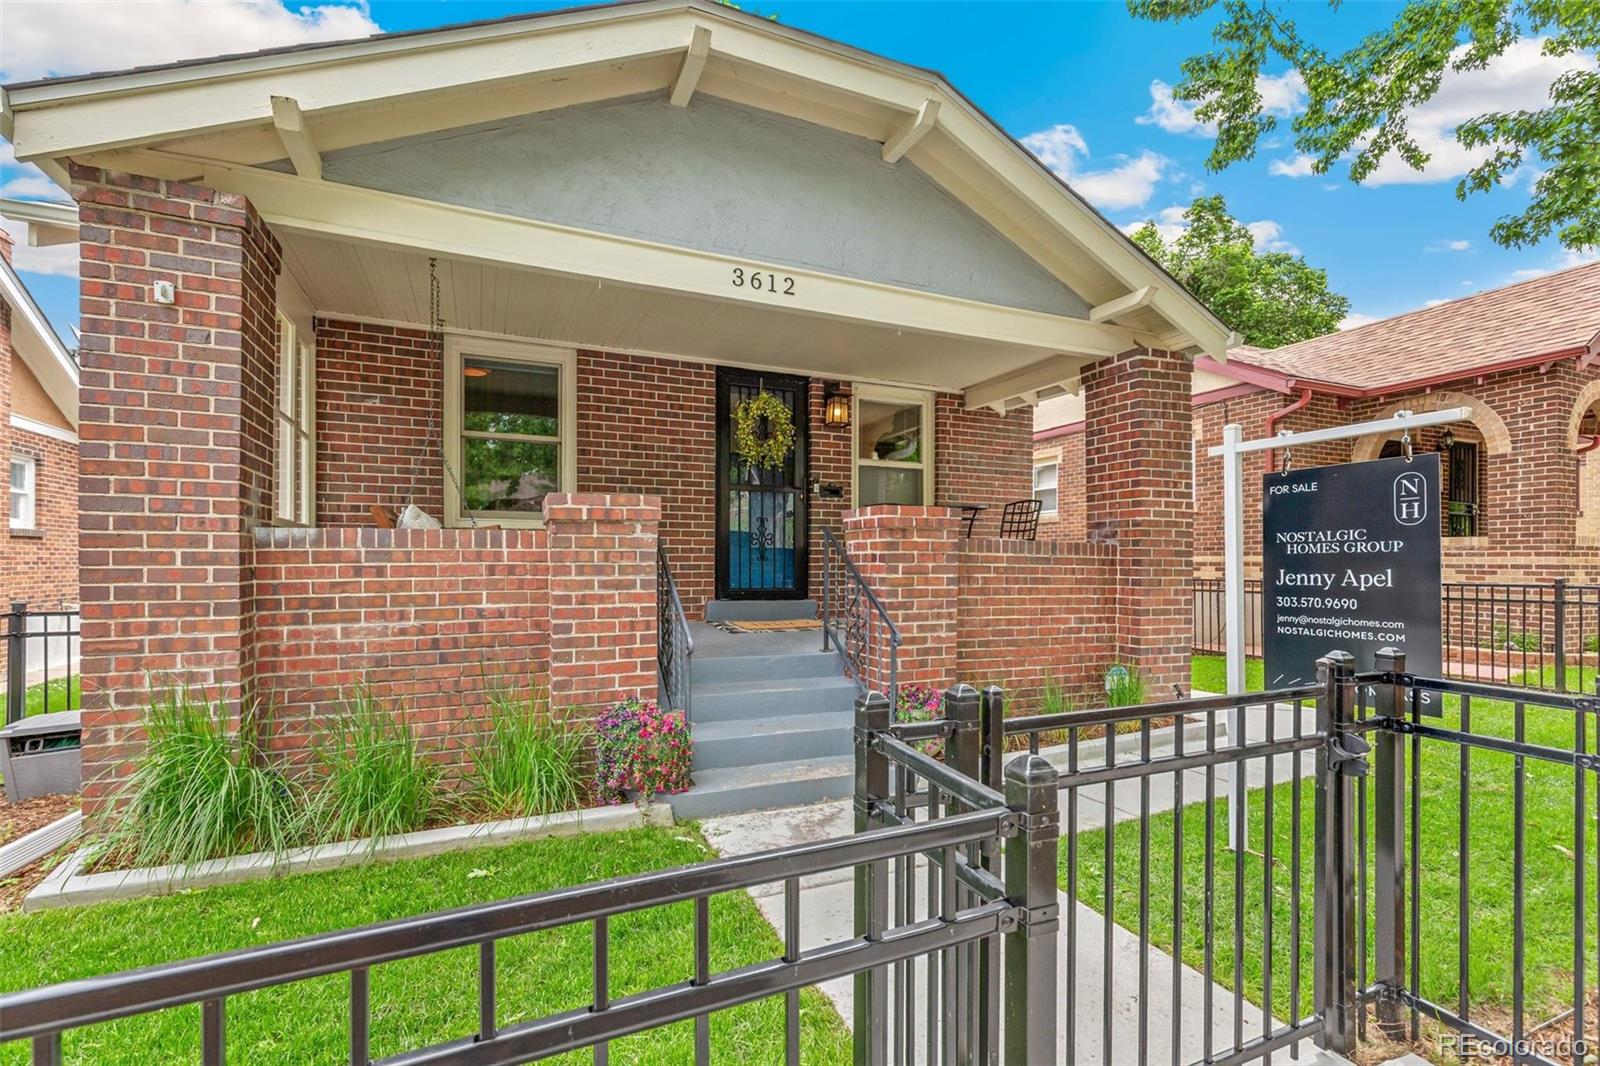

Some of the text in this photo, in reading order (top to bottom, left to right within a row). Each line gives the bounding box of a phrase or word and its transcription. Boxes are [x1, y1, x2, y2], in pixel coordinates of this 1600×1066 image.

[732, 267, 795, 296] 3612
[1269, 482, 1318, 495] FOR SALE
[1401, 478, 1420, 496] N
[1401, 501, 1420, 519] H
[1276, 529, 1367, 544] NOSTALGIC
[1287, 541, 1403, 555] HOMES GROUP
[1276, 568, 1393, 591] Jenny Apel
[1276, 596, 1358, 610] 303.570.9690
[1276, 615, 1405, 629] jenny@nostalgichomes.com
[1277, 626, 1406, 643] NOSTALGICHOMES.COM
